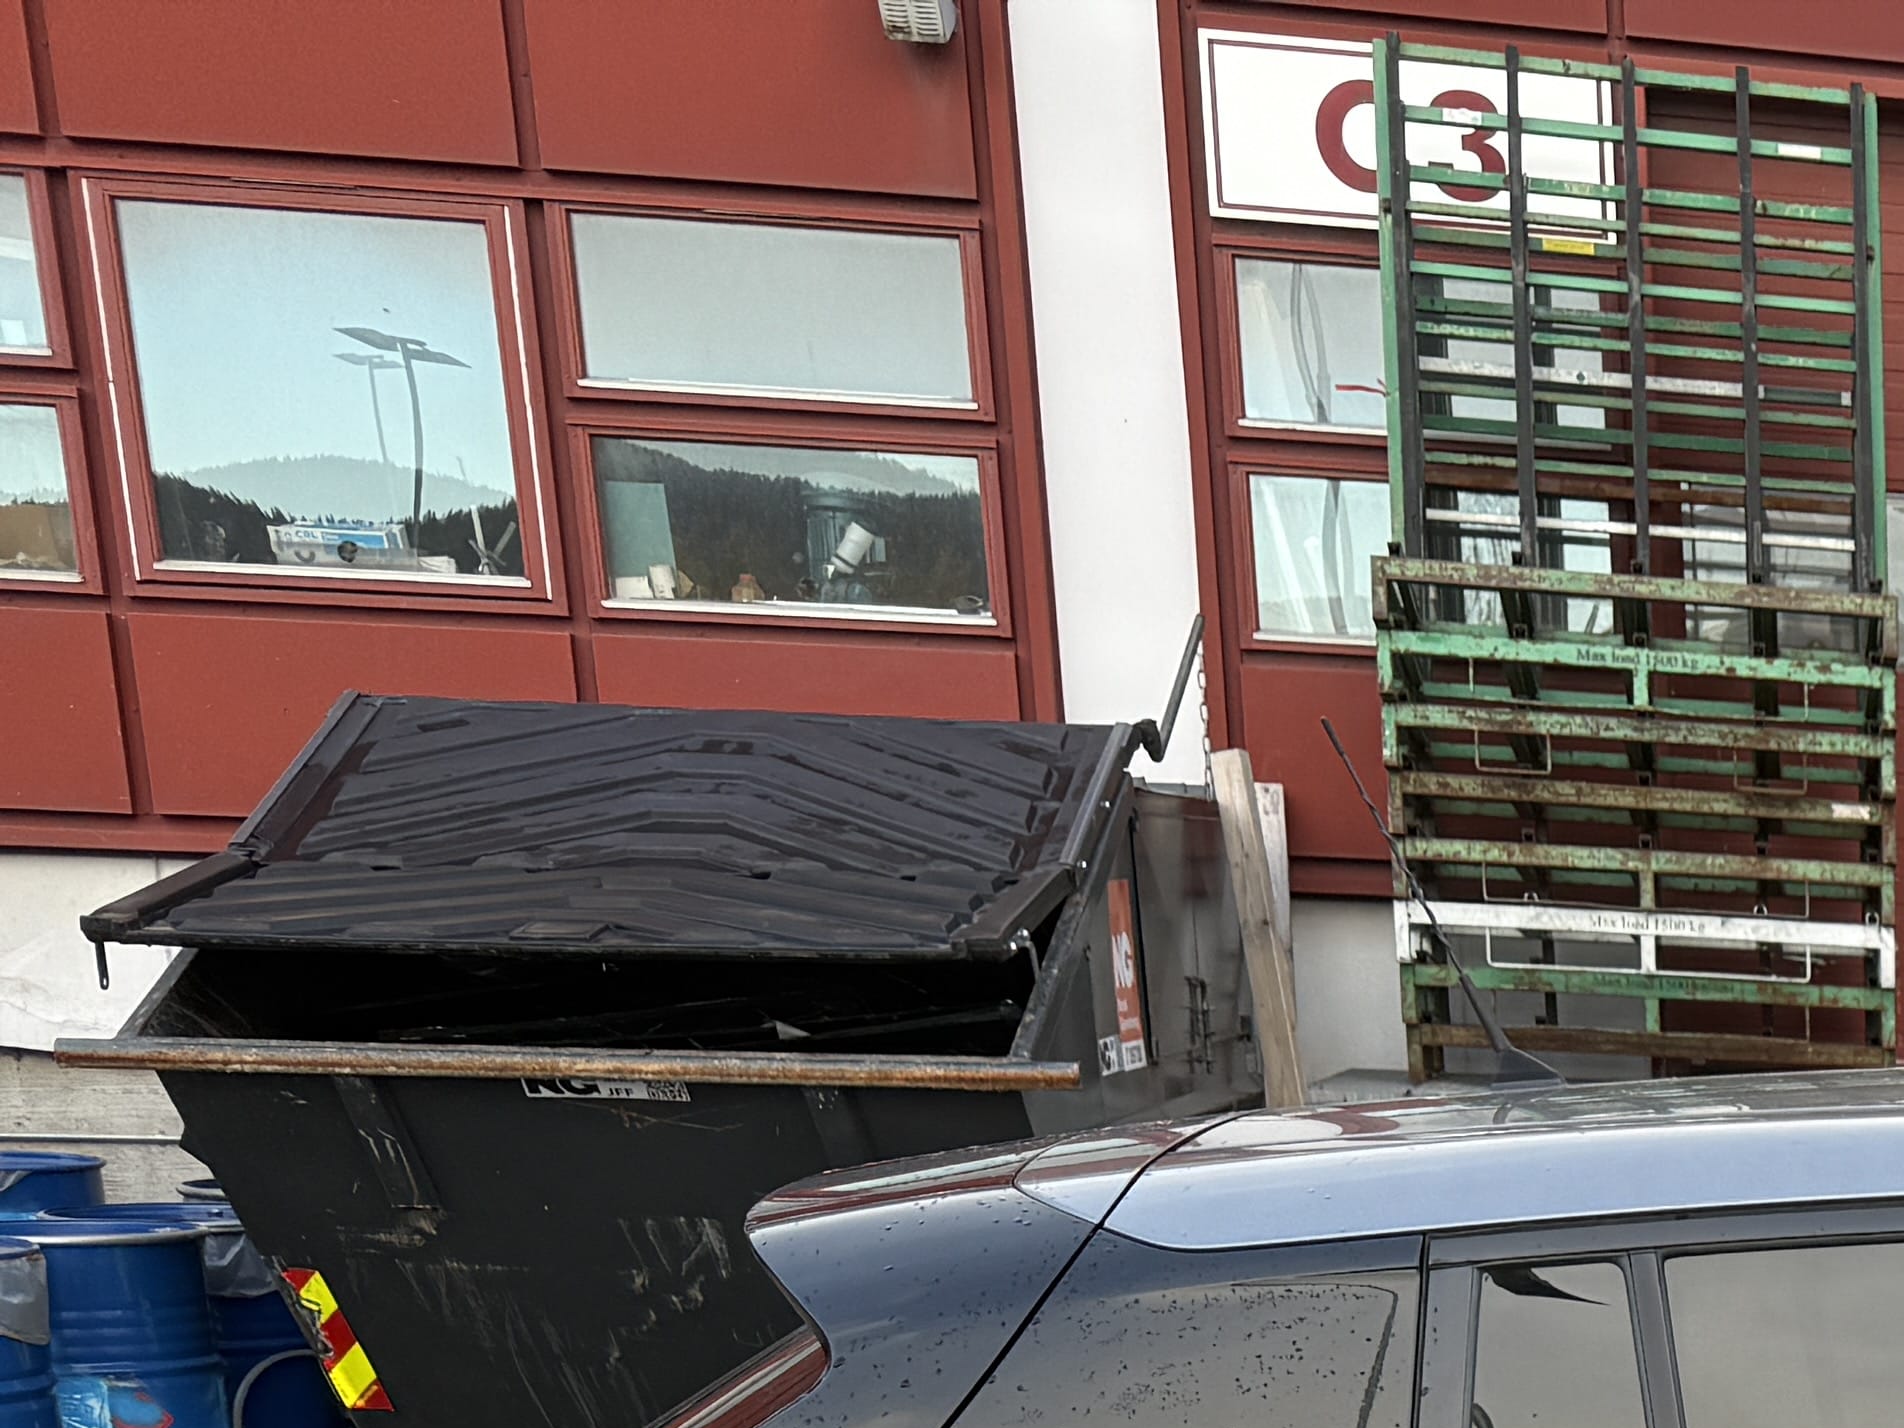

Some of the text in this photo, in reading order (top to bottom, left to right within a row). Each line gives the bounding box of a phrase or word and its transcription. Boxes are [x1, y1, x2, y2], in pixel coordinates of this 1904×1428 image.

[1577, 647, 1698, 670] Max load 1500 kg
